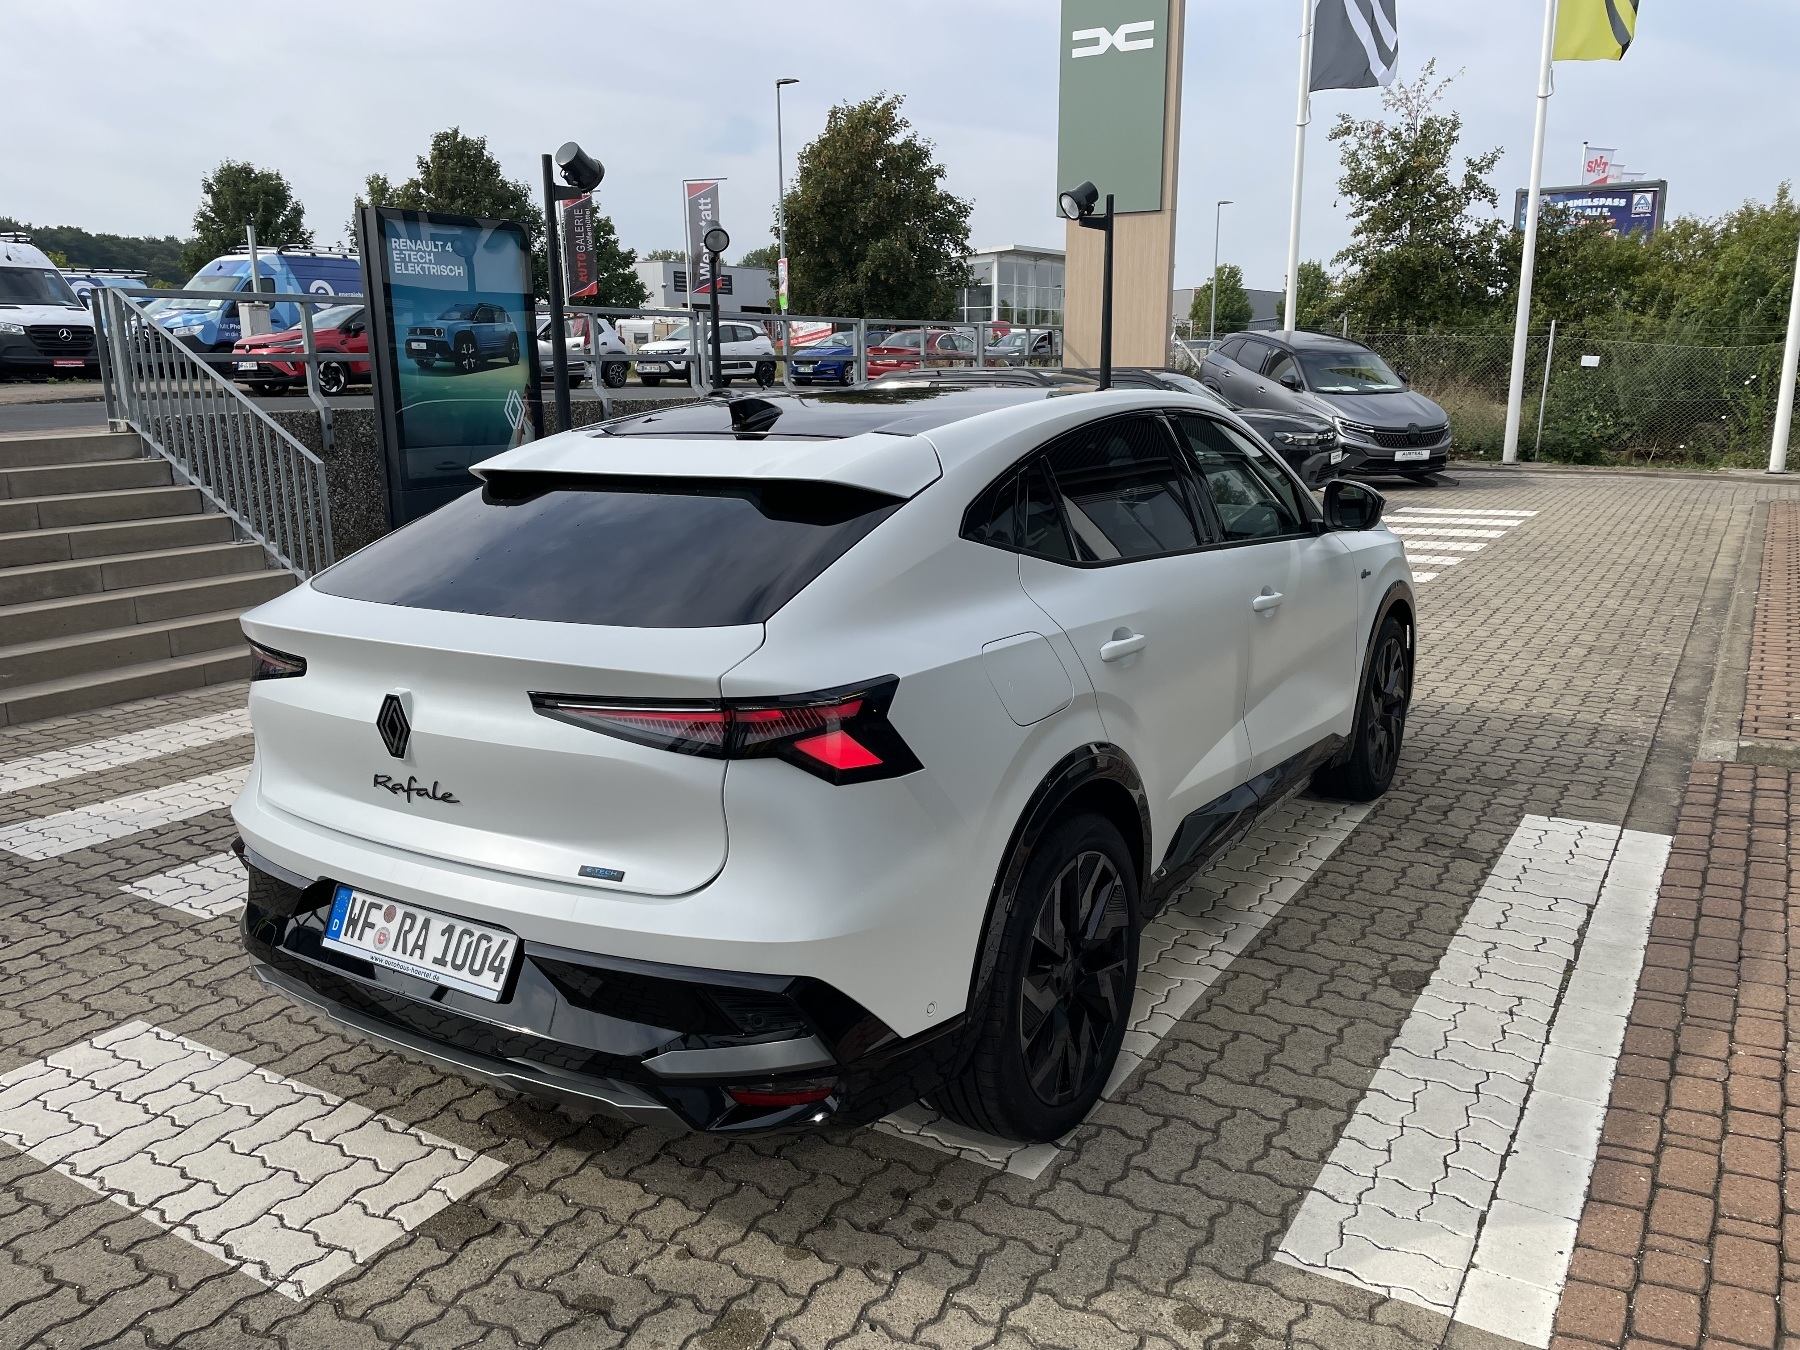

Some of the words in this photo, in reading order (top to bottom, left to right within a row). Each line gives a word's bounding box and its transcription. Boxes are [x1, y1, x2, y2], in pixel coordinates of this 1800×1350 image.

[1552, 197, 1627, 209] AMMELSPASS
[391, 238, 444, 252] RENAULT
[445, 242, 453, 253] 4
[392, 250, 435, 263] E-TECH
[394, 262, 464, 277] ELEKTRISCH
[373, 774, 461, 804] Rafale
[586, 866, 618, 876] E-TECH
[332, 919, 339, 931] D
[343, 896, 384, 942] WF
[392, 910, 432, 960] RA
[432, 922, 509, 983] 1004
[370, 955, 440, 982] www.autohaus-haertel.de
